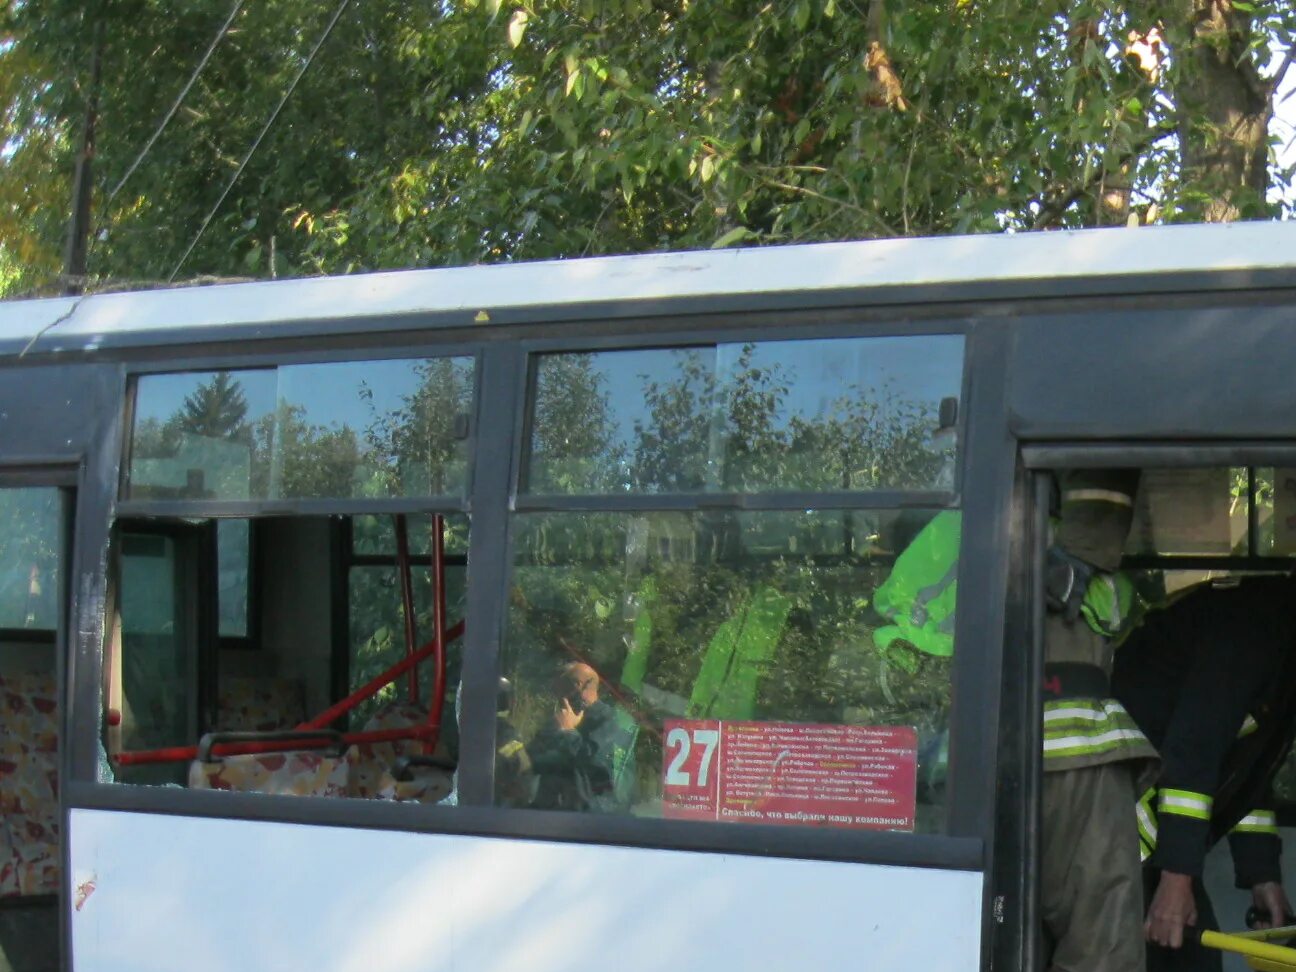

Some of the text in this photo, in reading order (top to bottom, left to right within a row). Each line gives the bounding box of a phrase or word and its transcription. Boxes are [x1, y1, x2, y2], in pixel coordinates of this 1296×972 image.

[665, 727, 718, 787] 27
[721, 807, 764, 819] Спасибо,
[784, 811, 826, 822] выбрали
[828, 814, 853, 824] нашу
[855, 815, 909, 826] компанию!
